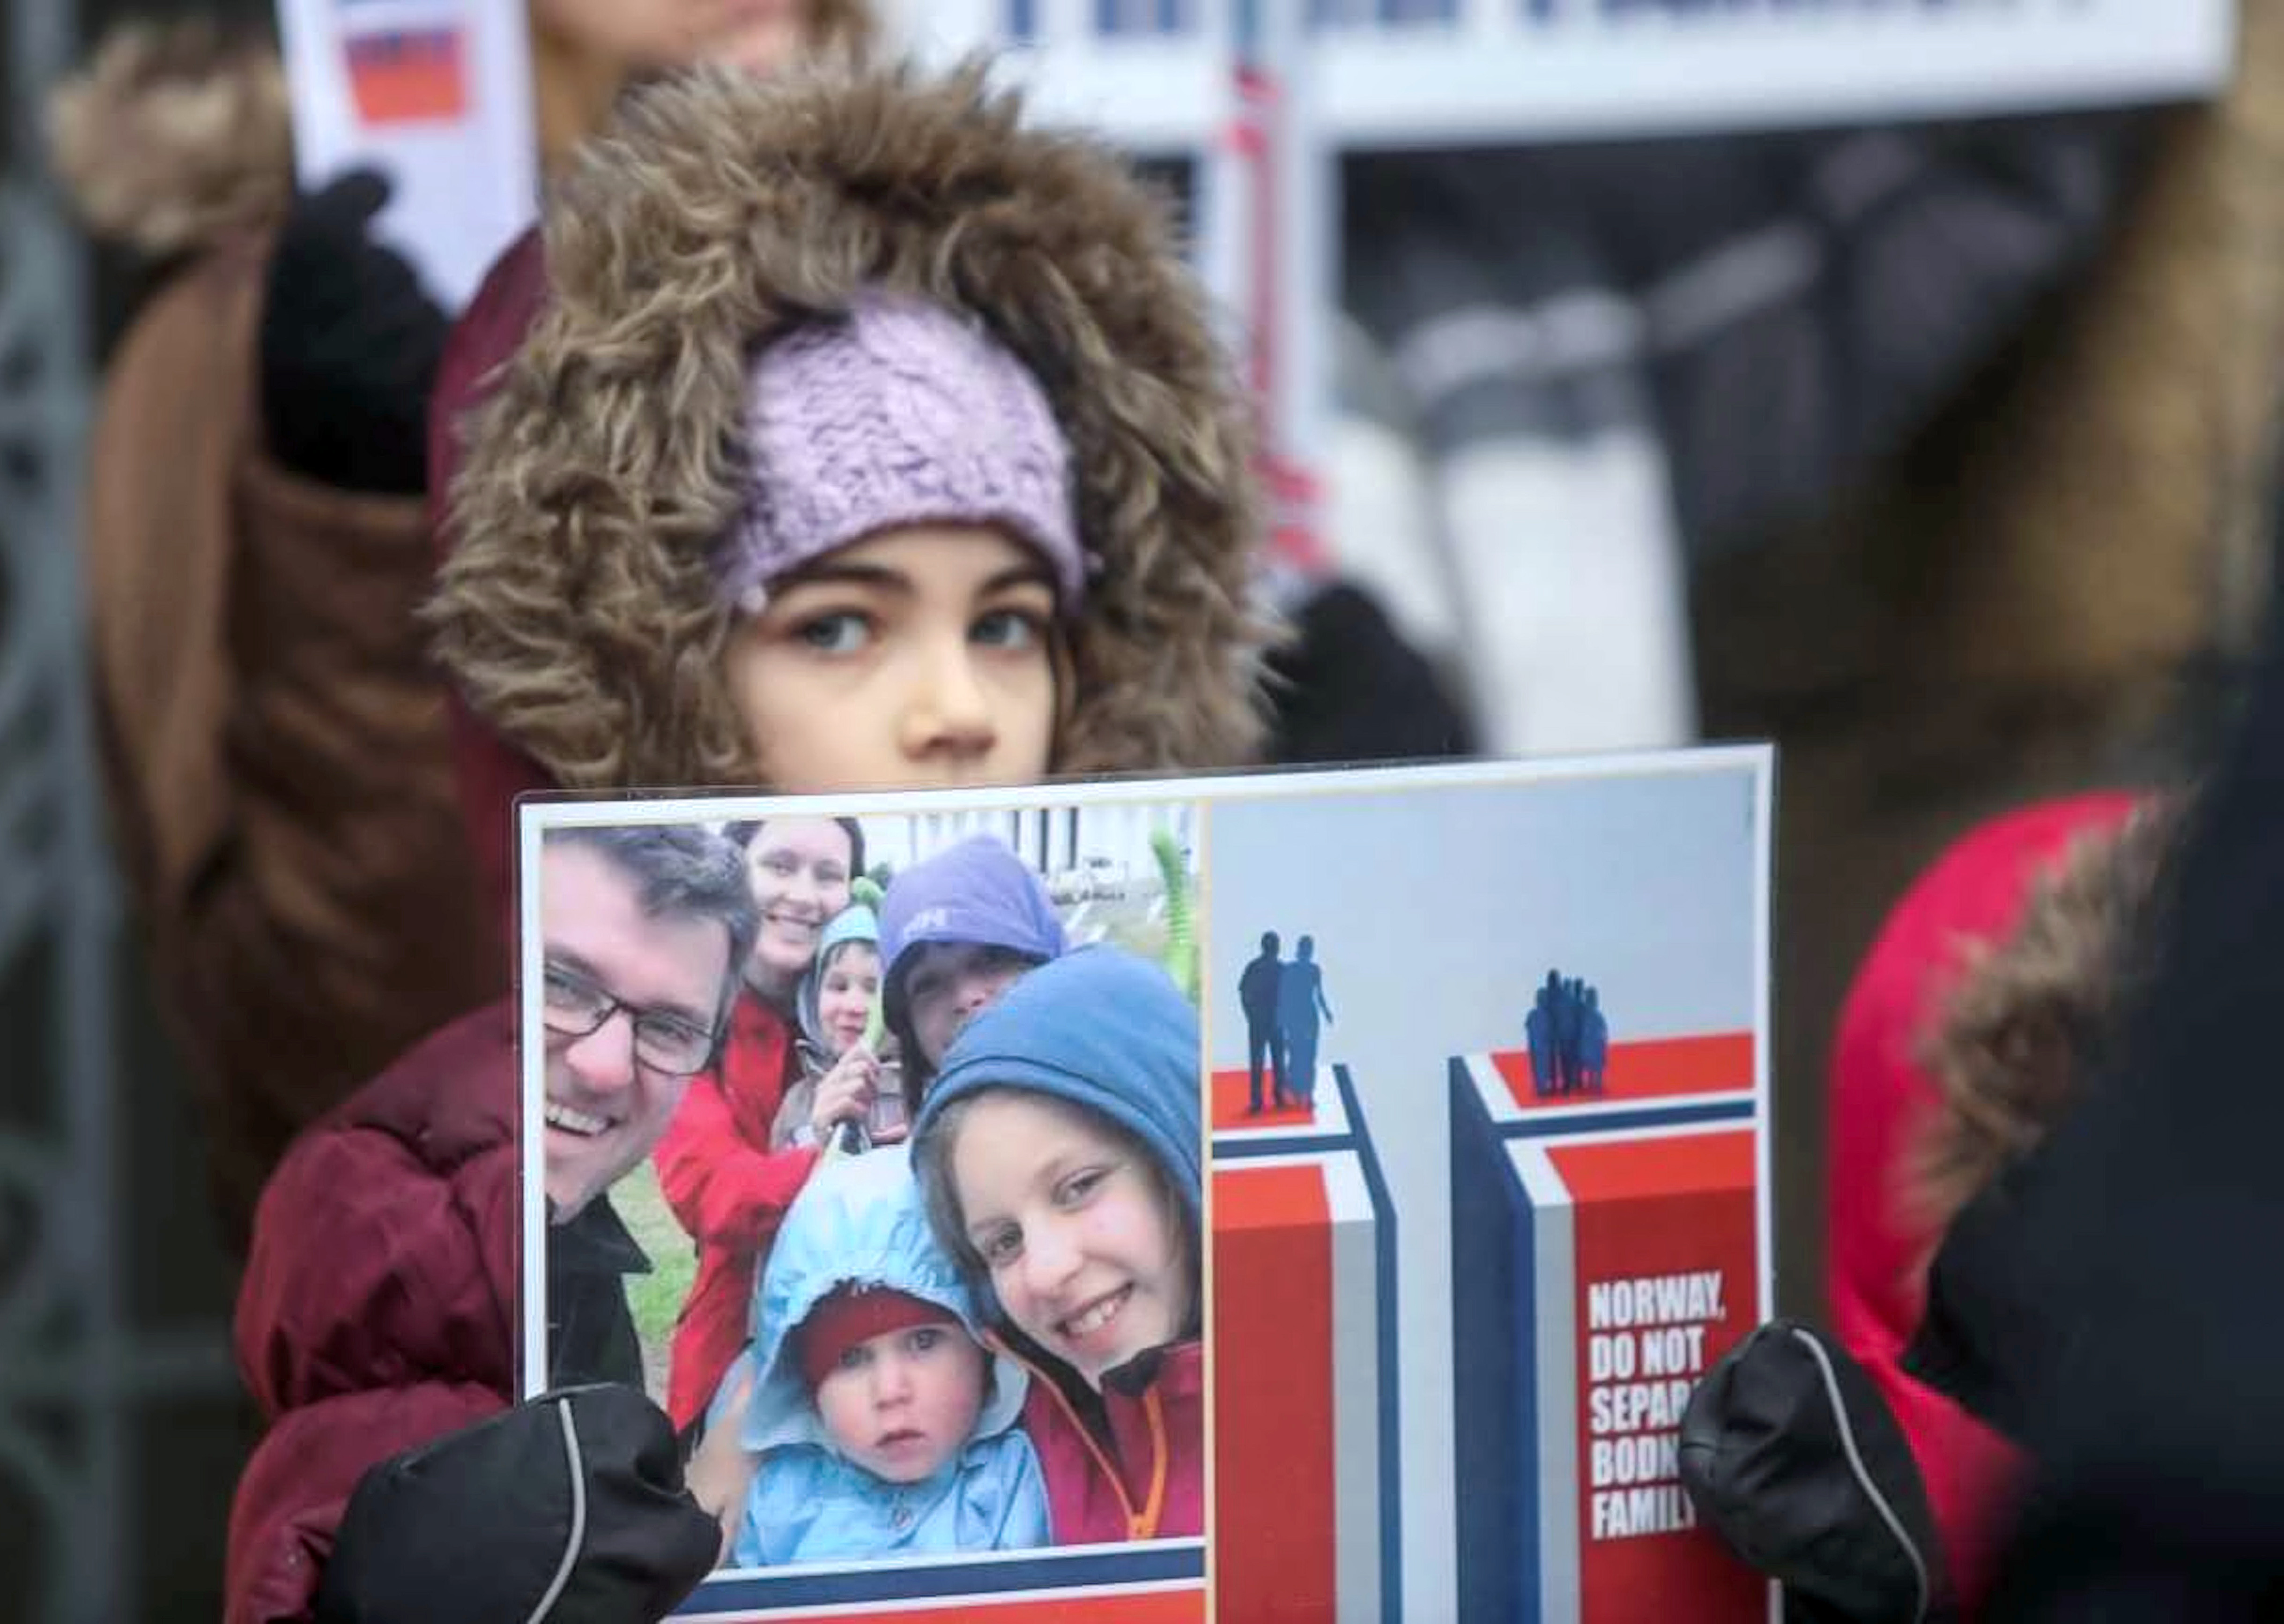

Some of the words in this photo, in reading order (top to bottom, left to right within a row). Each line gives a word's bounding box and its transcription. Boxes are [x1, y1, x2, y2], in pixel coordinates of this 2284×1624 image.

[1588, 1271, 1726, 1329] NORWAY,
[1590, 1333, 1635, 1381] DO
[1641, 1326, 1704, 1377] NOT
[1591, 1379, 1702, 1432] SEPAR
